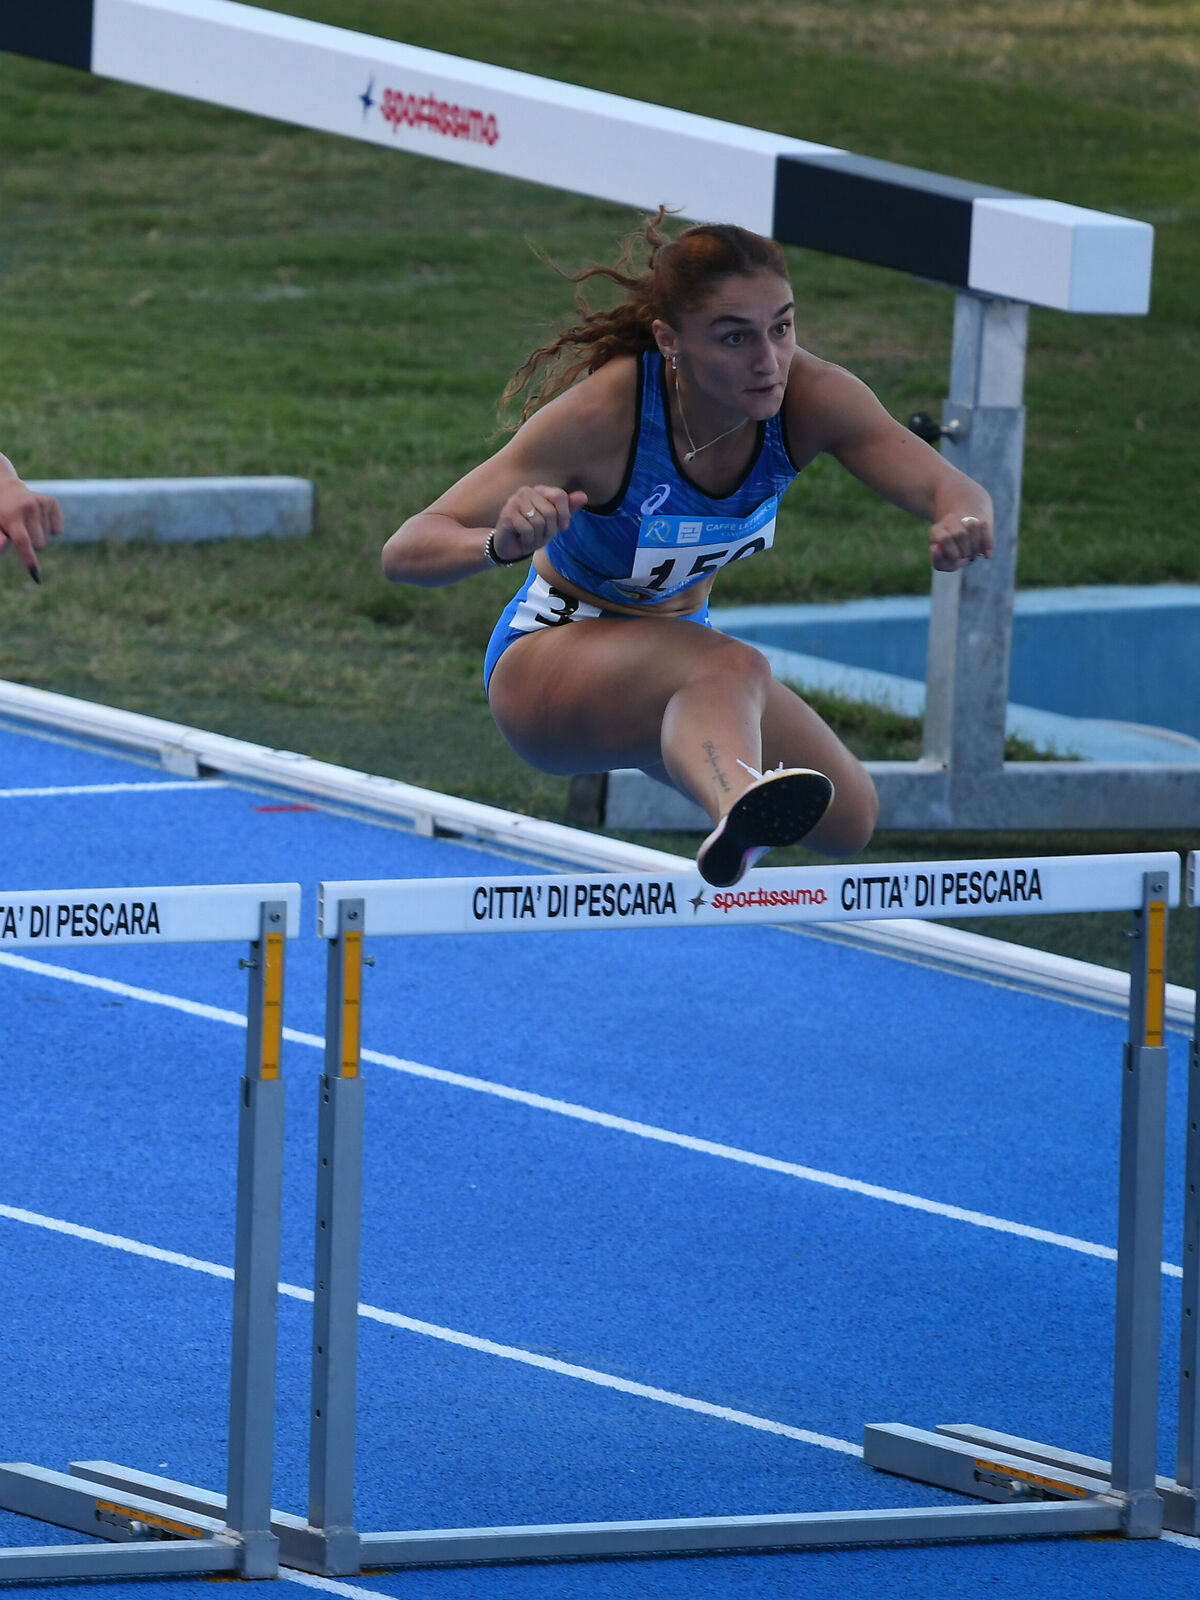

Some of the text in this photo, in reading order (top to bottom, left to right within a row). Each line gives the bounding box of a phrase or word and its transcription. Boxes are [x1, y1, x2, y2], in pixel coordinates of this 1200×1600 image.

[534, 586, 579, 627] 3
[472, 868, 1043, 920] CITTA' DI PESCARA sportissimo CITTA' DI PESCARA
[29, 905, 51, 938] DI
[56, 901, 161, 937] PESCARA
